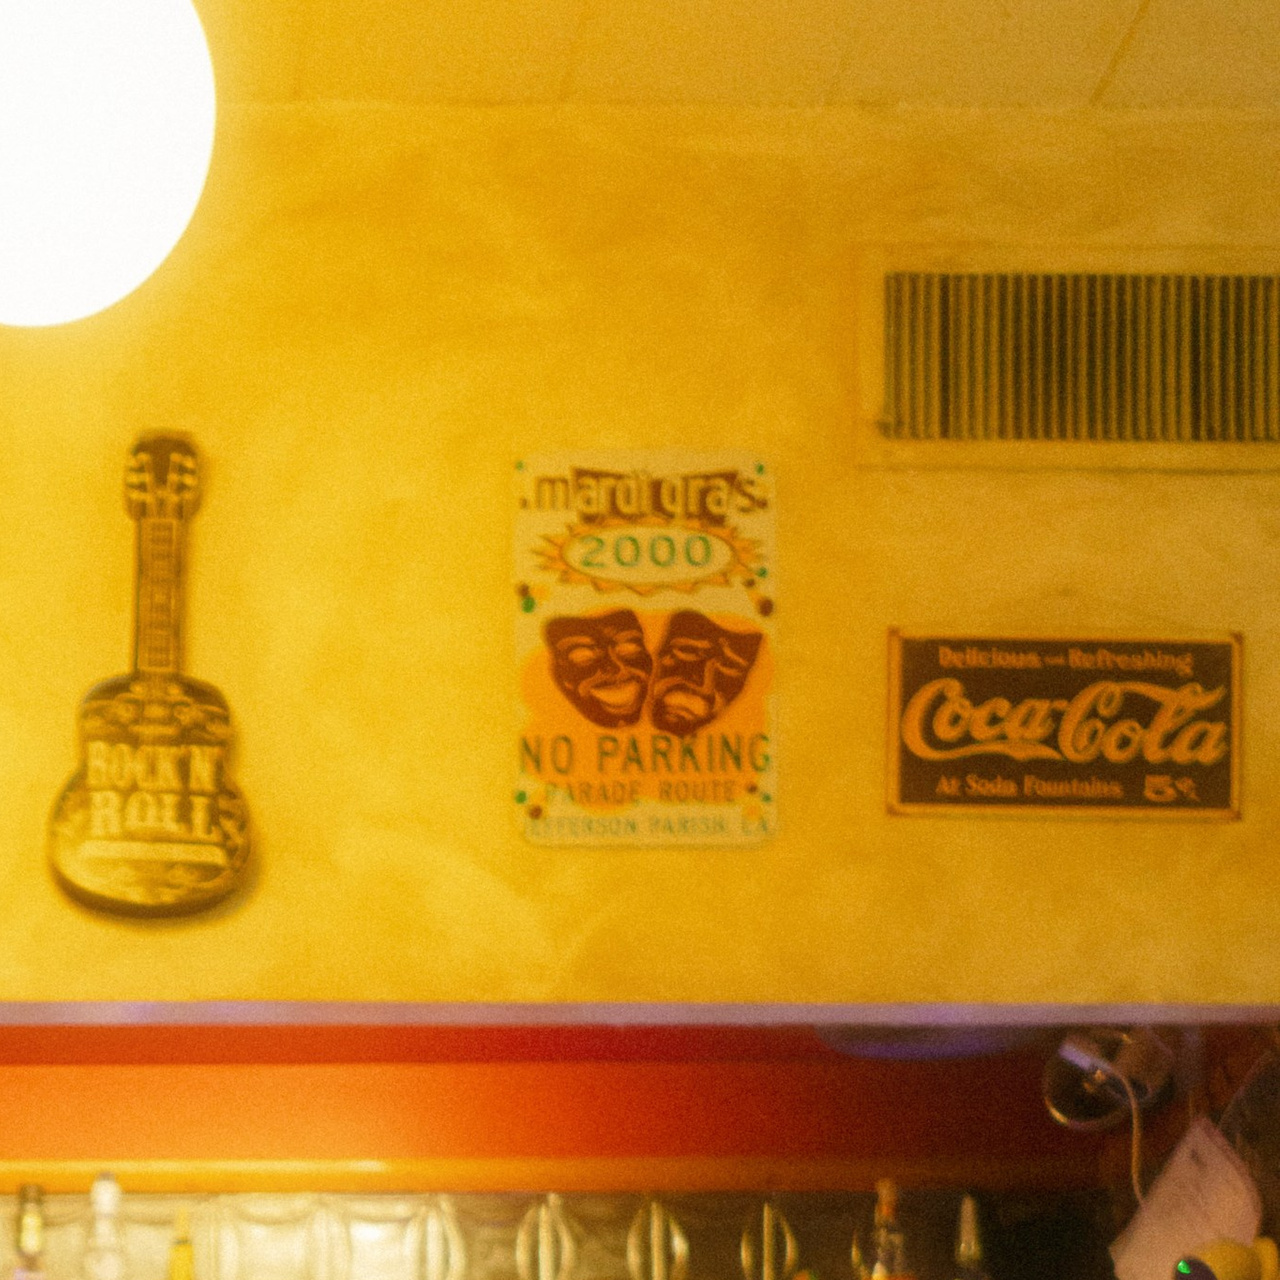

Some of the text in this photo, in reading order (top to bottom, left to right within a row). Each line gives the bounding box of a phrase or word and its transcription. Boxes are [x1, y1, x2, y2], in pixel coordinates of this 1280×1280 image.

[581, 535, 712, 567] 2000
[938, 646, 1194, 677] Delicious Refreshing
[521, 733, 771, 774] NO PARKING
[546, 779, 737, 804] PARADE ROUTE
[965, 773, 1018, 797] Soda
[1023, 774, 1124, 798] Fountains
